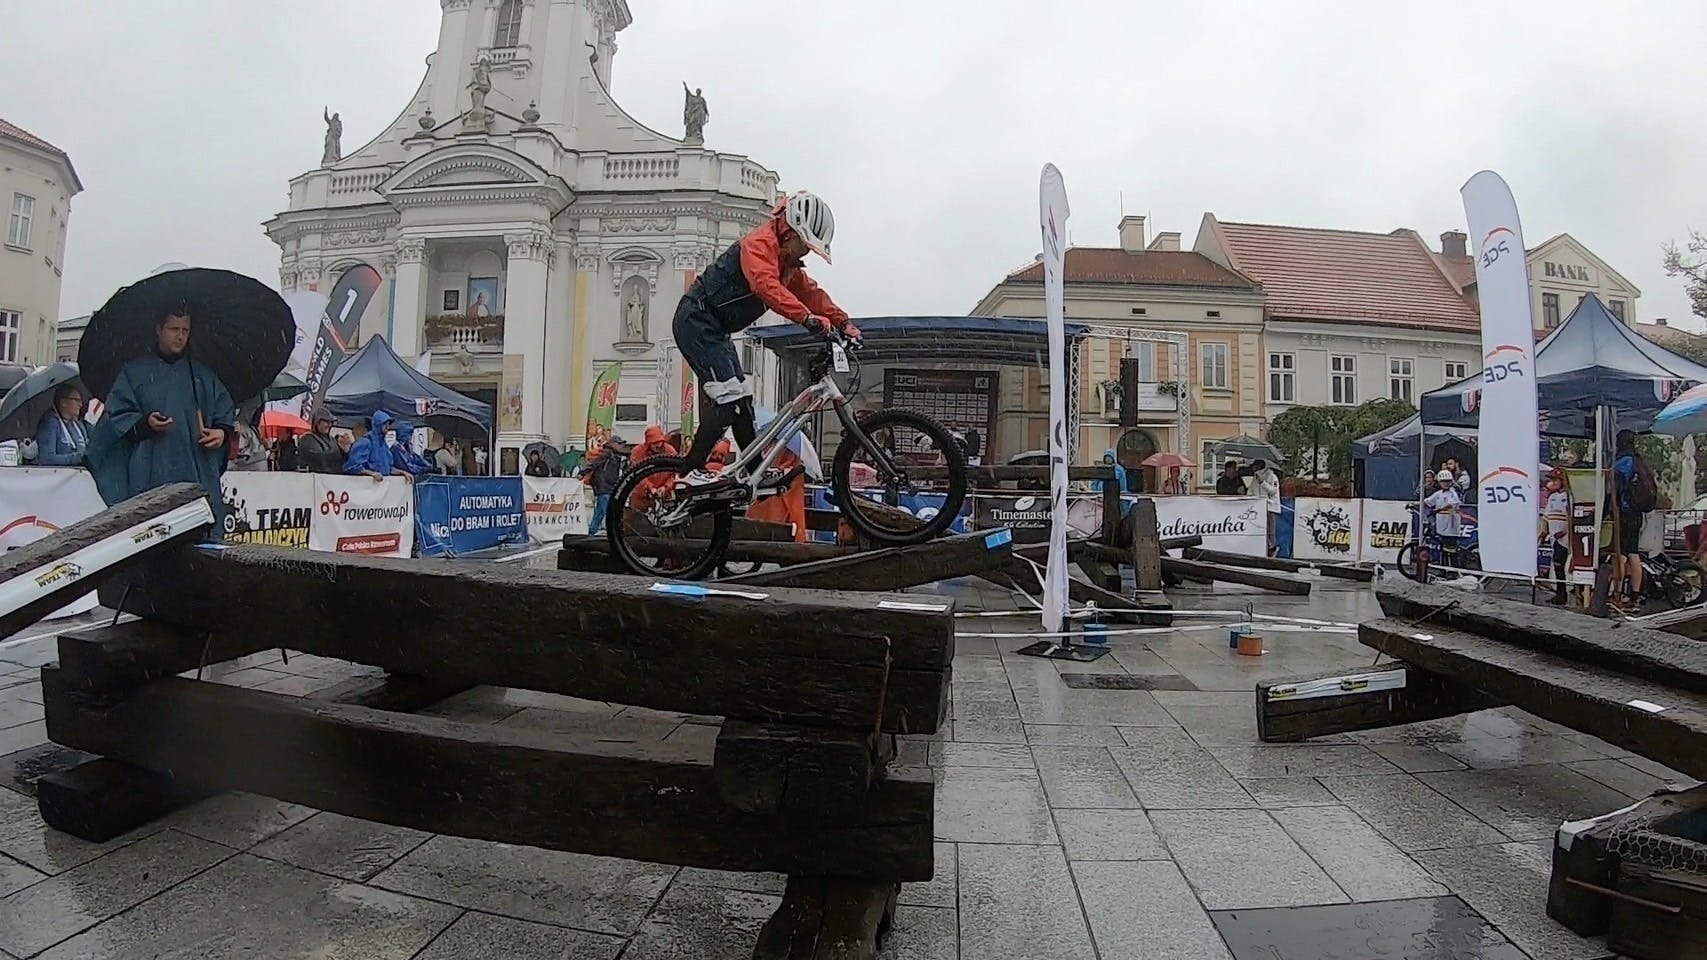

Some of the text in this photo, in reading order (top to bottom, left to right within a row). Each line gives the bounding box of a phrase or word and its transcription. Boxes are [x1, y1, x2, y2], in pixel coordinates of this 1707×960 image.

[1544, 261, 1590, 282] BANK
[339, 288, 358, 324] 1
[310, 346, 333, 393] GAMES
[343, 501, 409, 522] rowerowa.pl
[459, 496, 513, 511] AUTOMATYKA
[990, 507, 1053, 520] Timemaste
[256, 507, 312, 530] TEAM
[451, 516, 464, 532] DO
[466, 515, 490, 530] BRAM
[496, 513, 522, 528] ROLET
[1581, 535, 1589, 556] 1
